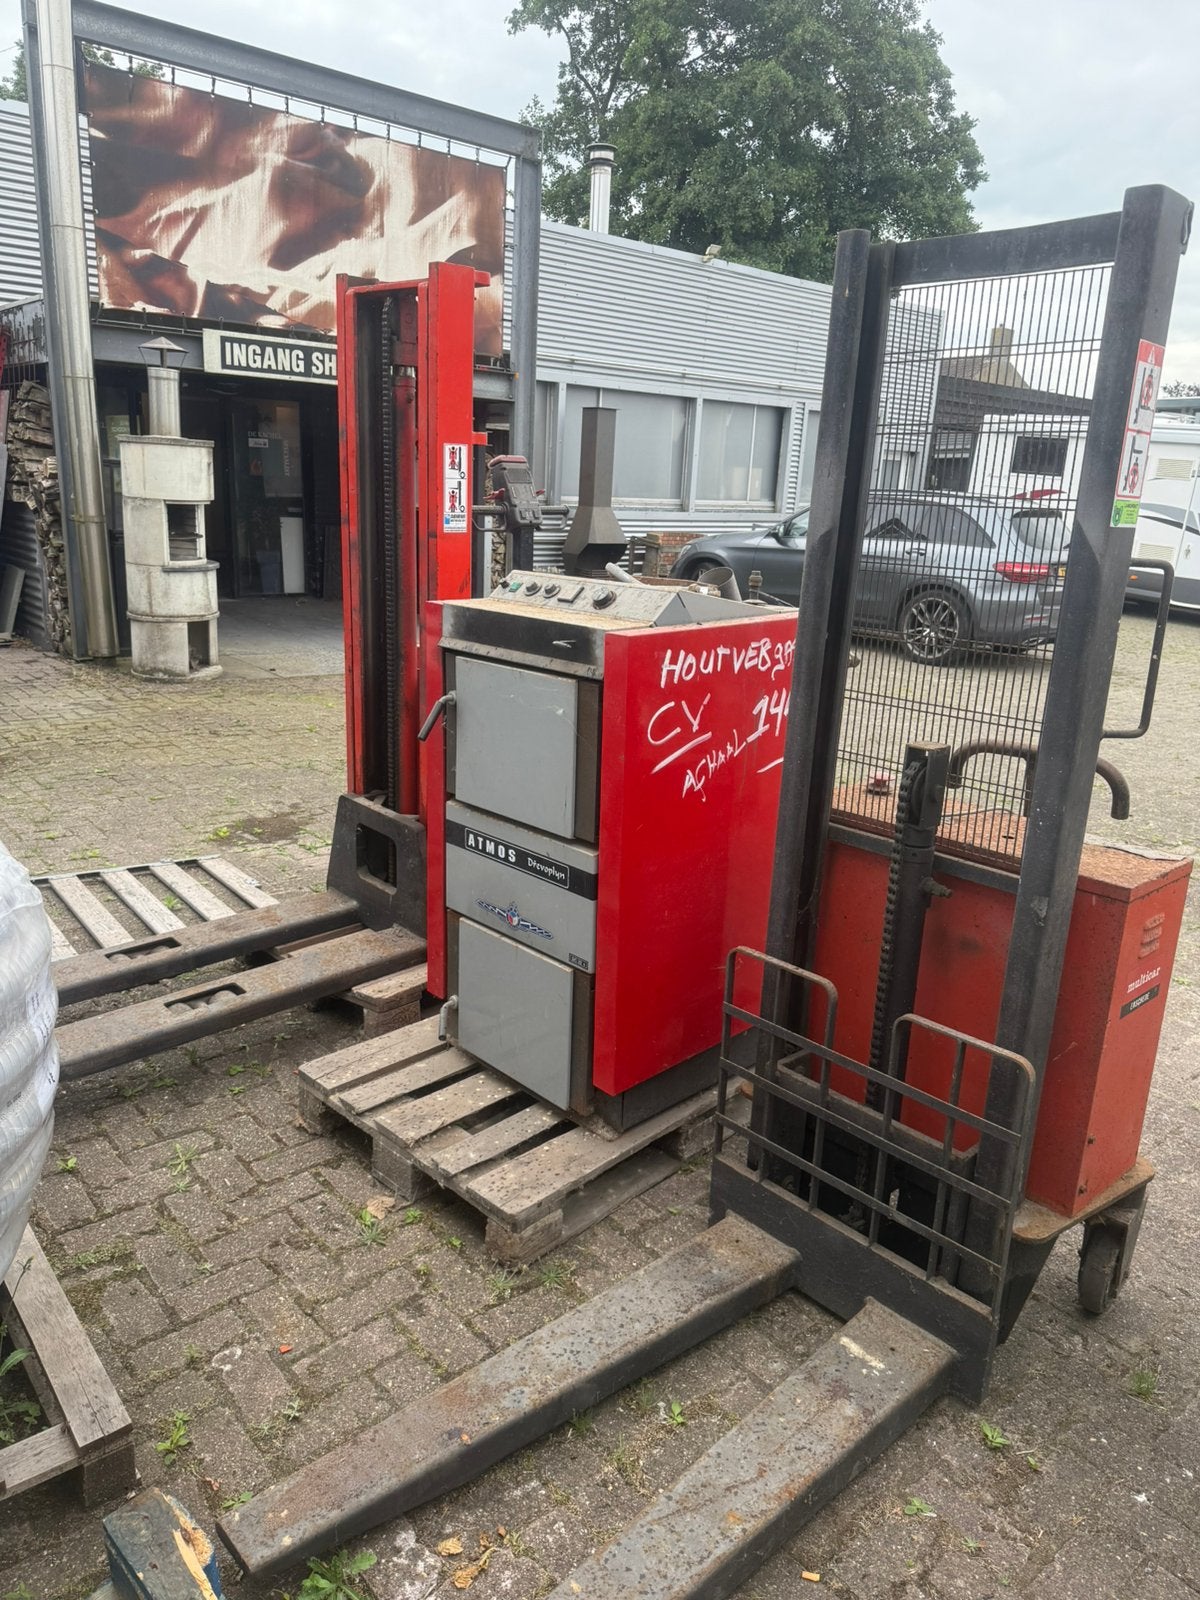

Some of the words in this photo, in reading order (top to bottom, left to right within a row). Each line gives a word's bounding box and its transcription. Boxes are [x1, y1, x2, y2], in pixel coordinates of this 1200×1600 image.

[225, 341, 305, 373] INGANG
[311, 351, 338, 377] SH
[647, 693, 711, 746] CV
[746, 687, 792, 743] 14
[467, 833, 517, 863] ATMOS
[1126, 966, 1161, 993] multicar
